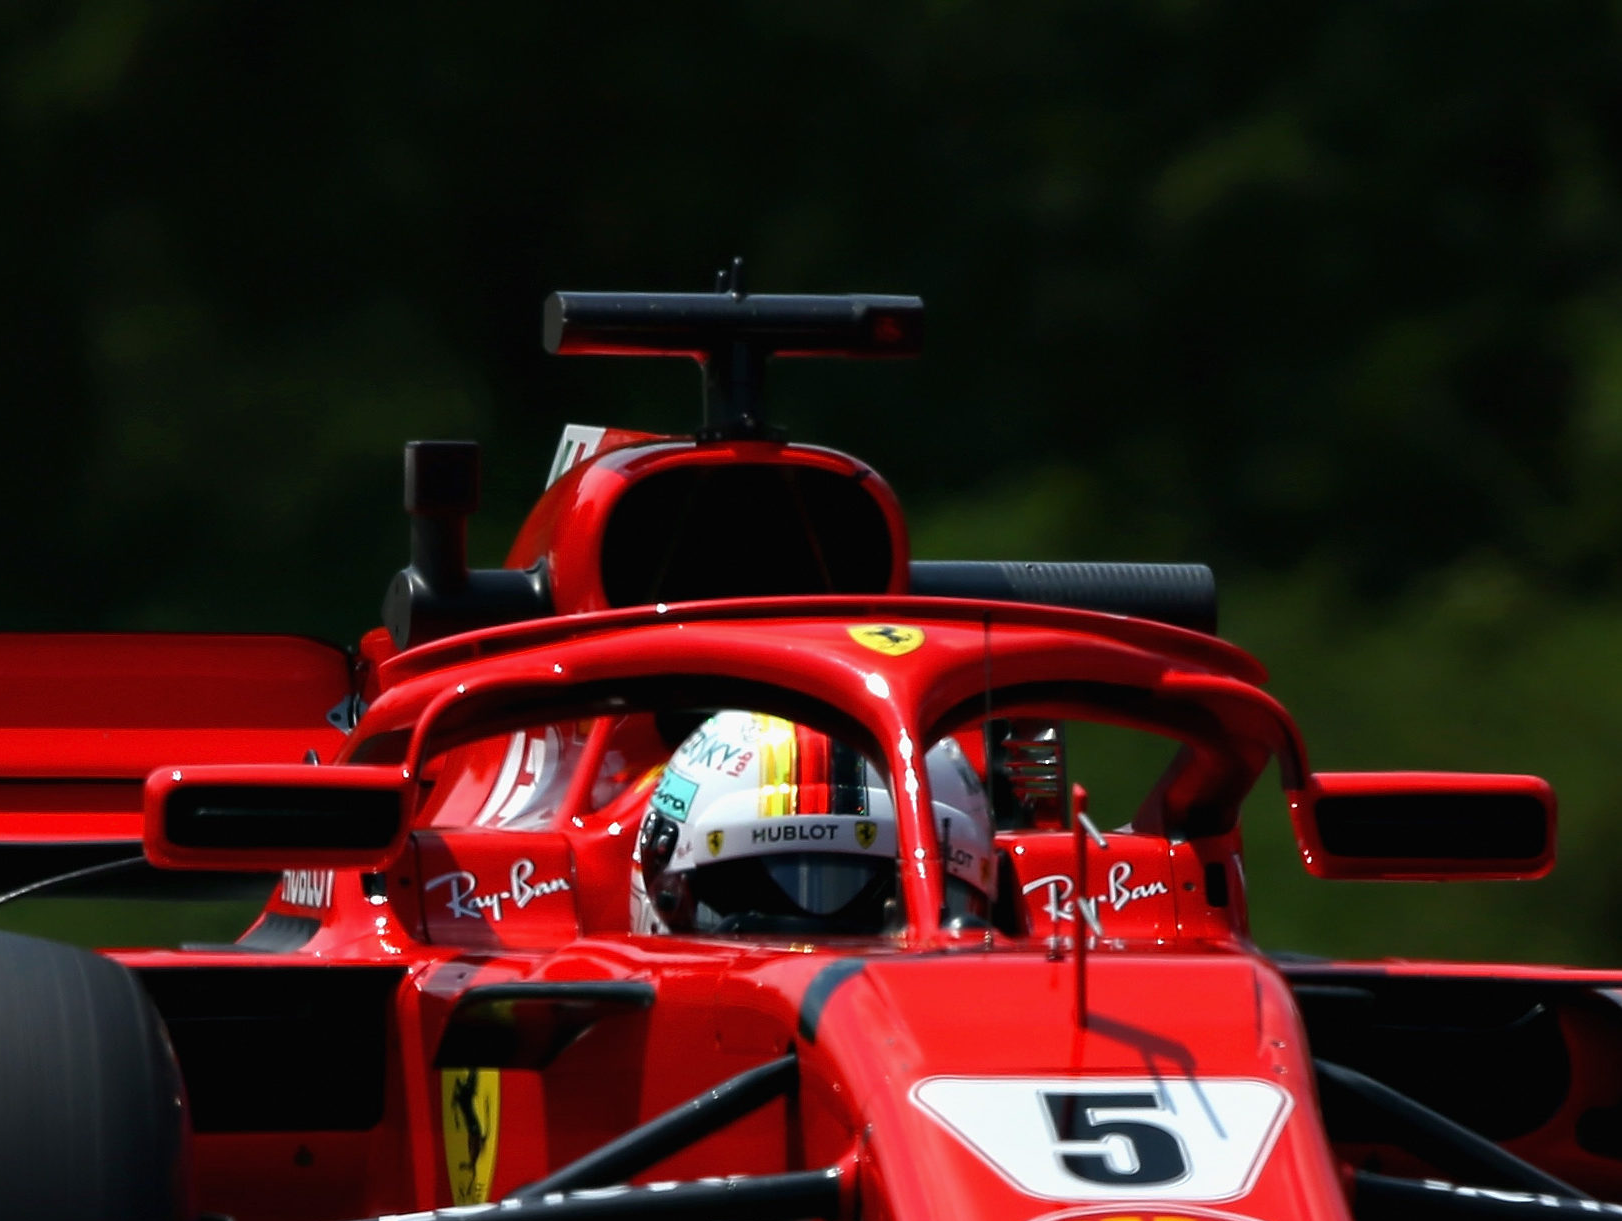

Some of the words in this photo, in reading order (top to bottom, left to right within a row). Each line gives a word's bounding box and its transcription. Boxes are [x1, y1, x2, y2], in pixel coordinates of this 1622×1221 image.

[751, 824, 839, 844] HUBLOT
[425, 858, 571, 921] Ray-Ban
[1037, 1090, 1195, 1188] 5
